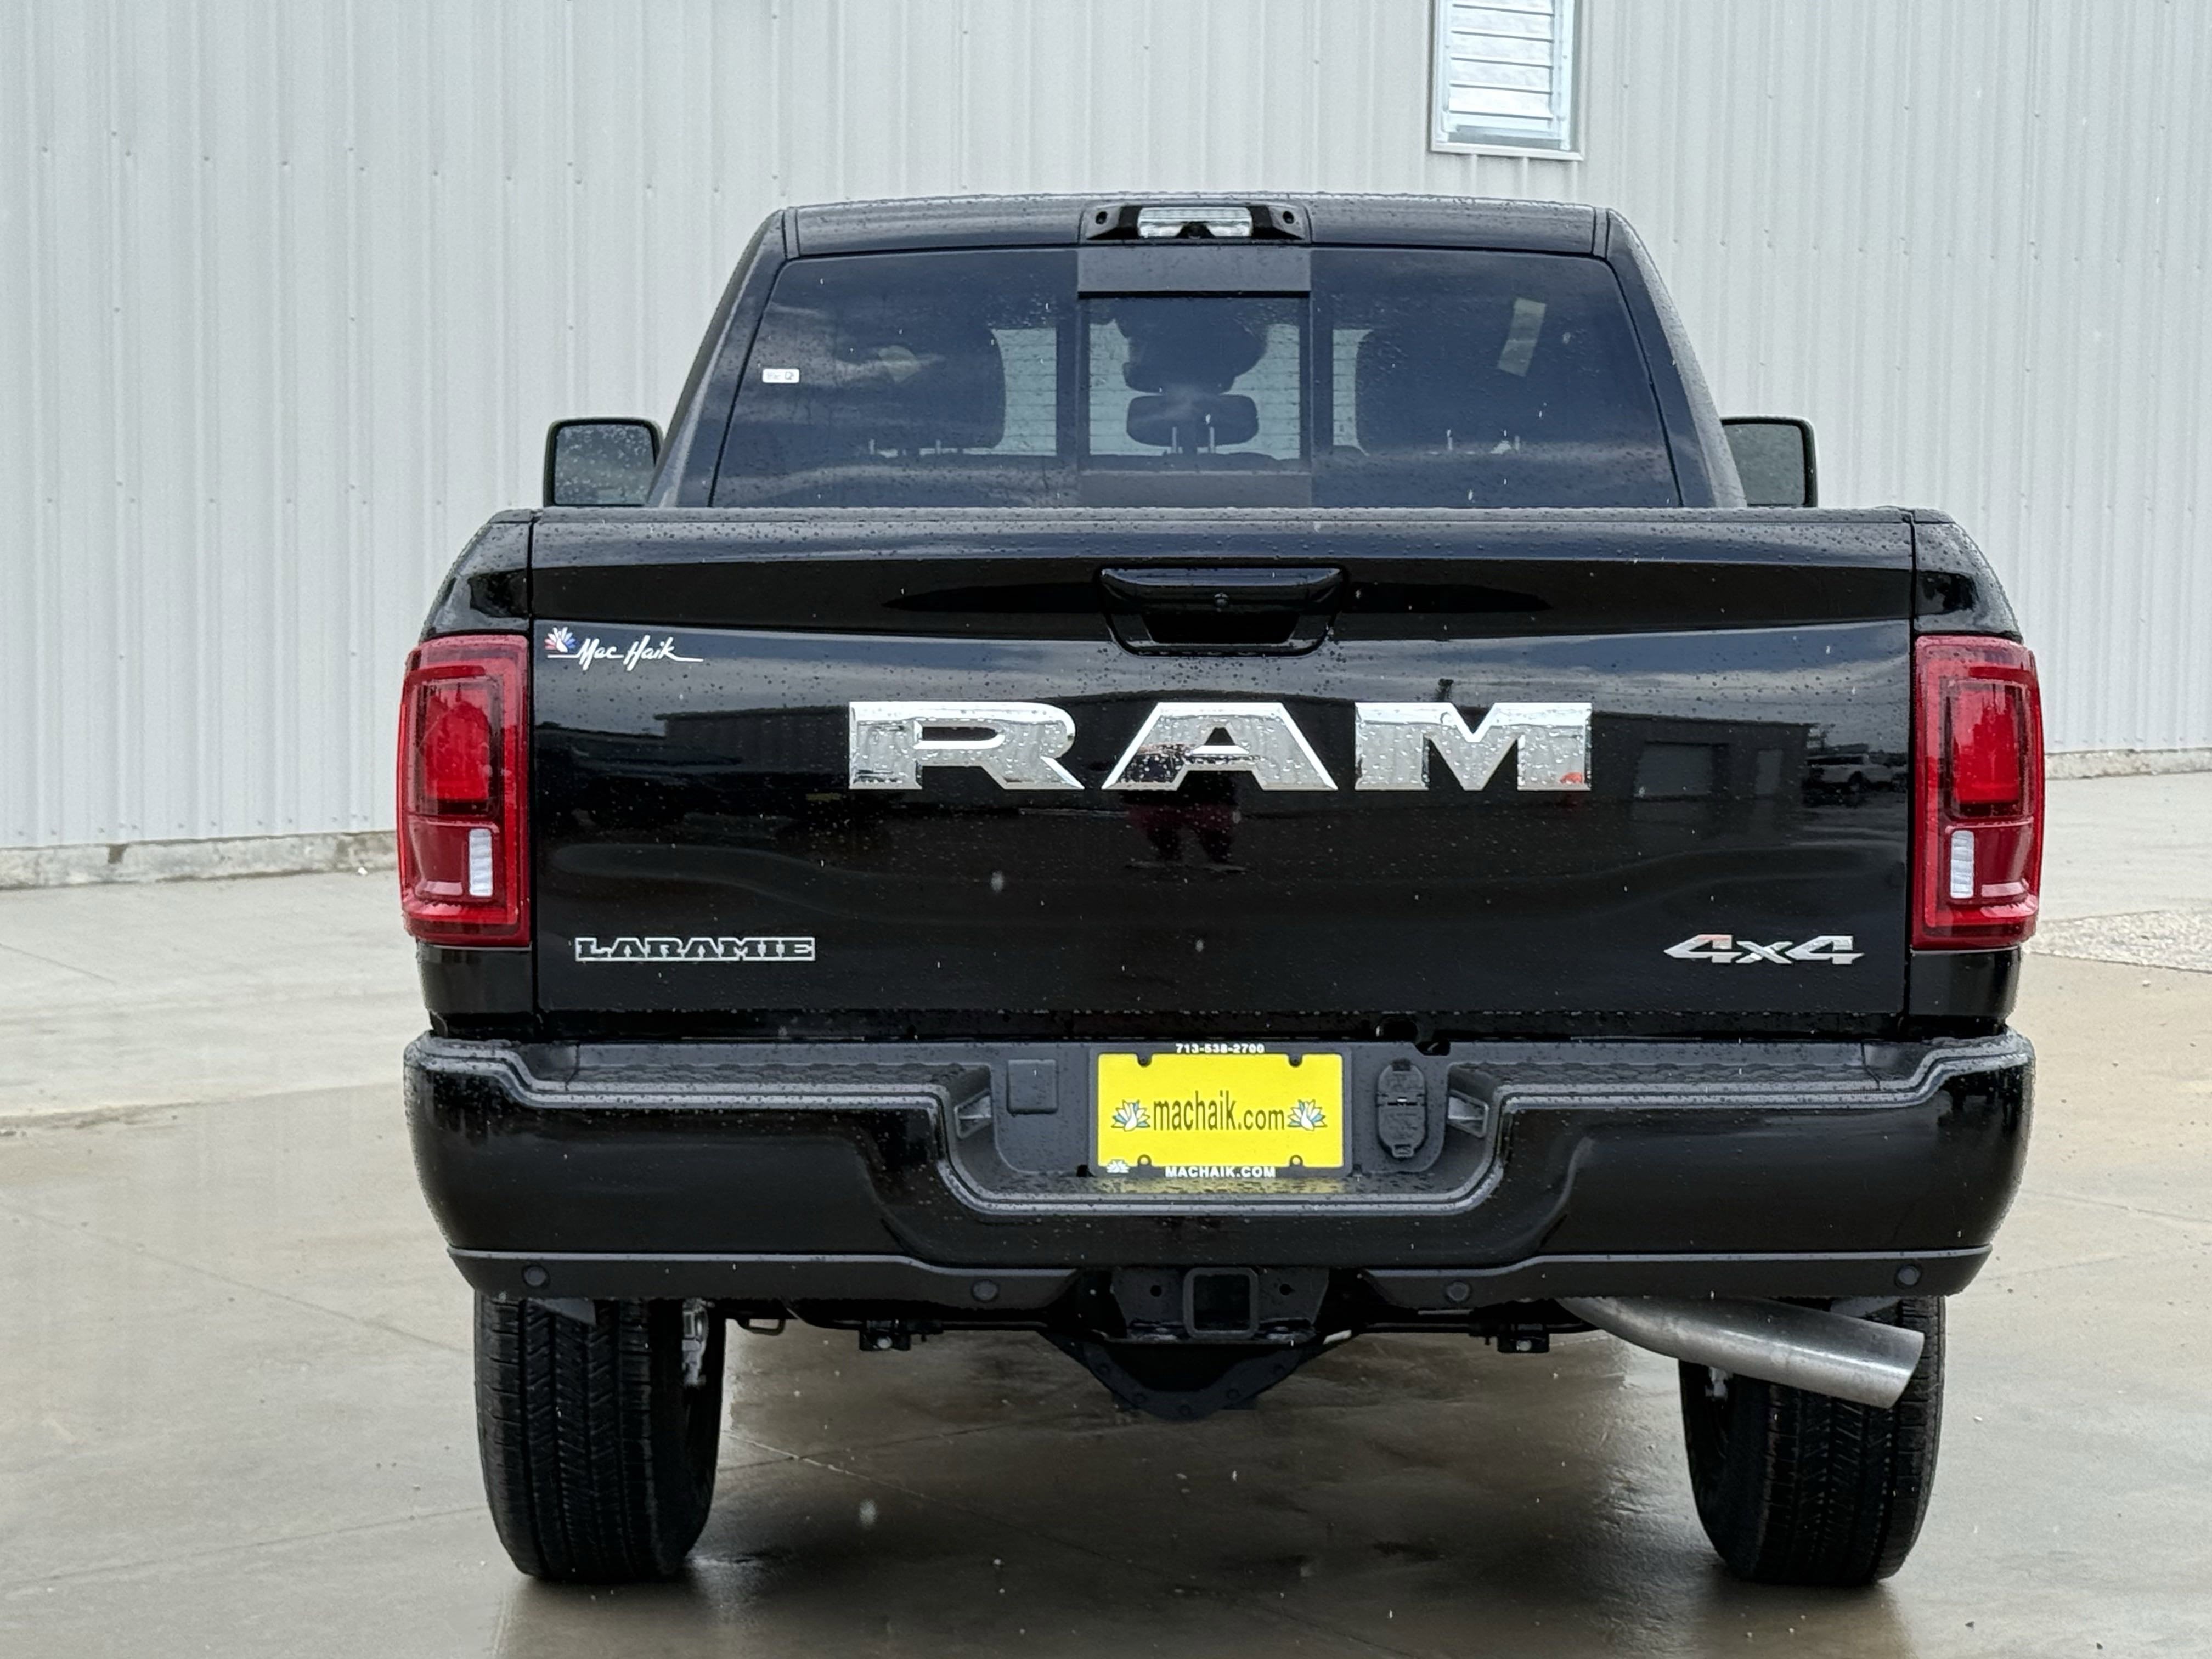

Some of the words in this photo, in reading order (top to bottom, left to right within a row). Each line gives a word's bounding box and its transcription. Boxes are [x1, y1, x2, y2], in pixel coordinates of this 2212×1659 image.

[577, 638, 624, 672] Mac
[623, 635, 681, 672] Haik
[848, 701, 1593, 791] RAM
[574, 936, 816, 962] LARAMIE
[1663, 934, 1866, 966] 4x4
[1175, 1043, 1265, 1054] 713-538-2700
[1153, 1090, 1285, 1131] machaik.com
[1164, 1166, 1276, 1178] MACHAIK.COM
